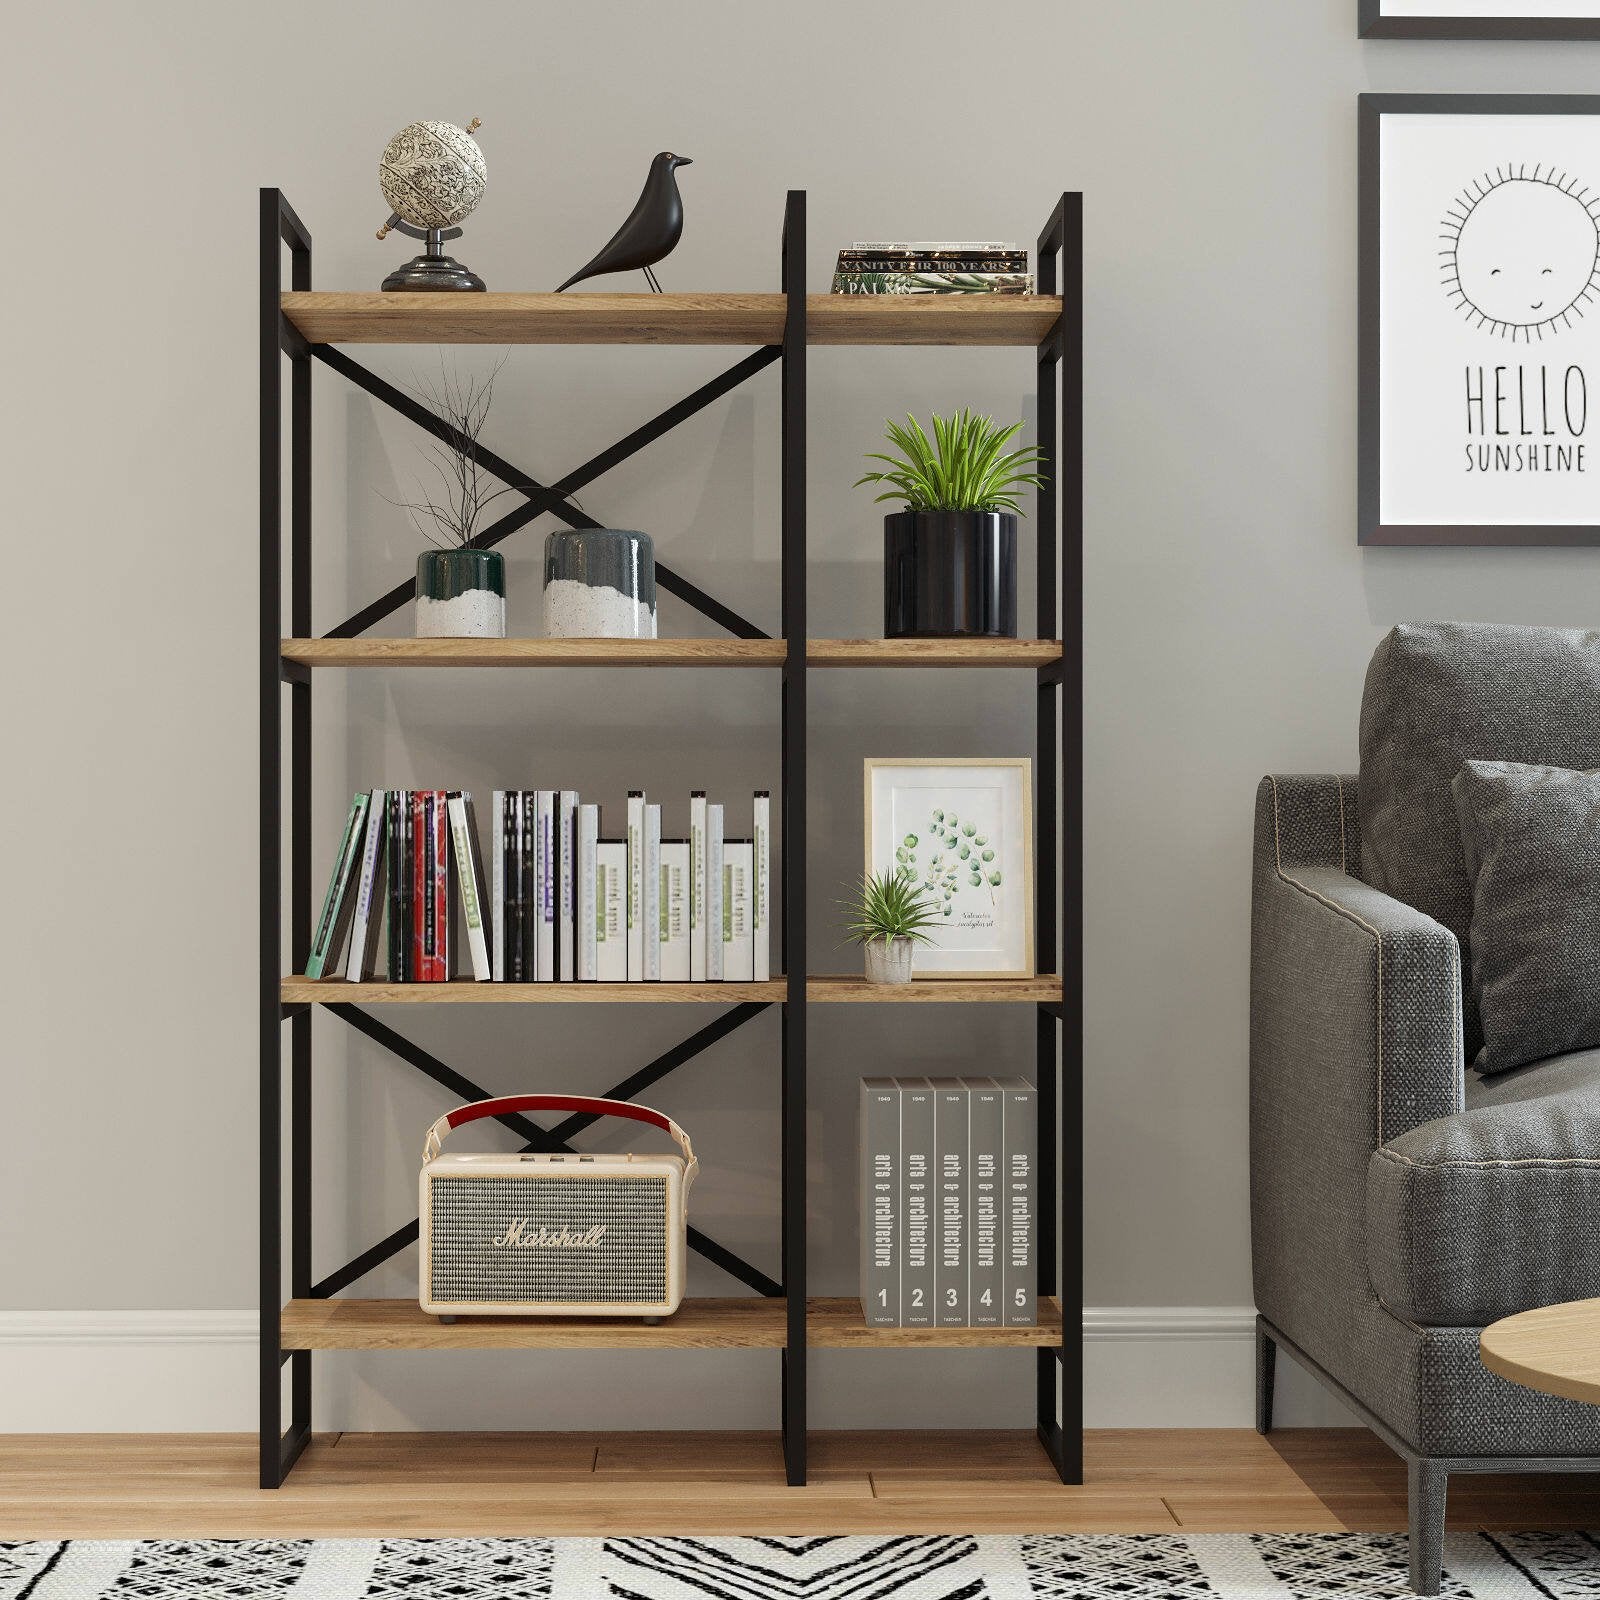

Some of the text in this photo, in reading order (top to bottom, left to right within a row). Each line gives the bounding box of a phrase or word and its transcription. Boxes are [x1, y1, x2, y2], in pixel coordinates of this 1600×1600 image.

[841, 261, 895, 270] VANITY
[937, 261, 957, 270] 100
[960, 261, 1006, 270] YEARS
[849, 282, 912, 294] PALMS
[1465, 365, 1587, 436] HELLO
[1466, 444, 1585, 472] SUNSHINE
[875, 1154, 892, 1177] arts
[909, 1154, 927, 1177] arts
[944, 1154, 961, 1177] arts
[978, 1154, 996, 1177] arts
[1012, 1154, 1030, 1177] arts
[493, 1217, 607, 1248] Marshall
[875, 1196, 894, 1267] architecture
[909, 1196, 929, 1267] architecture
[944, 1196, 963, 1267] architecture
[978, 1196, 997, 1267] architecture
[1012, 1196, 1031, 1267] architecture
[878, 1289, 887, 1306] 1
[911, 1289, 924, 1306] 2
[946, 1289, 958, 1306] 3
[980, 1289, 992, 1306] 4
[1014, 1289, 1026, 1306] 5
